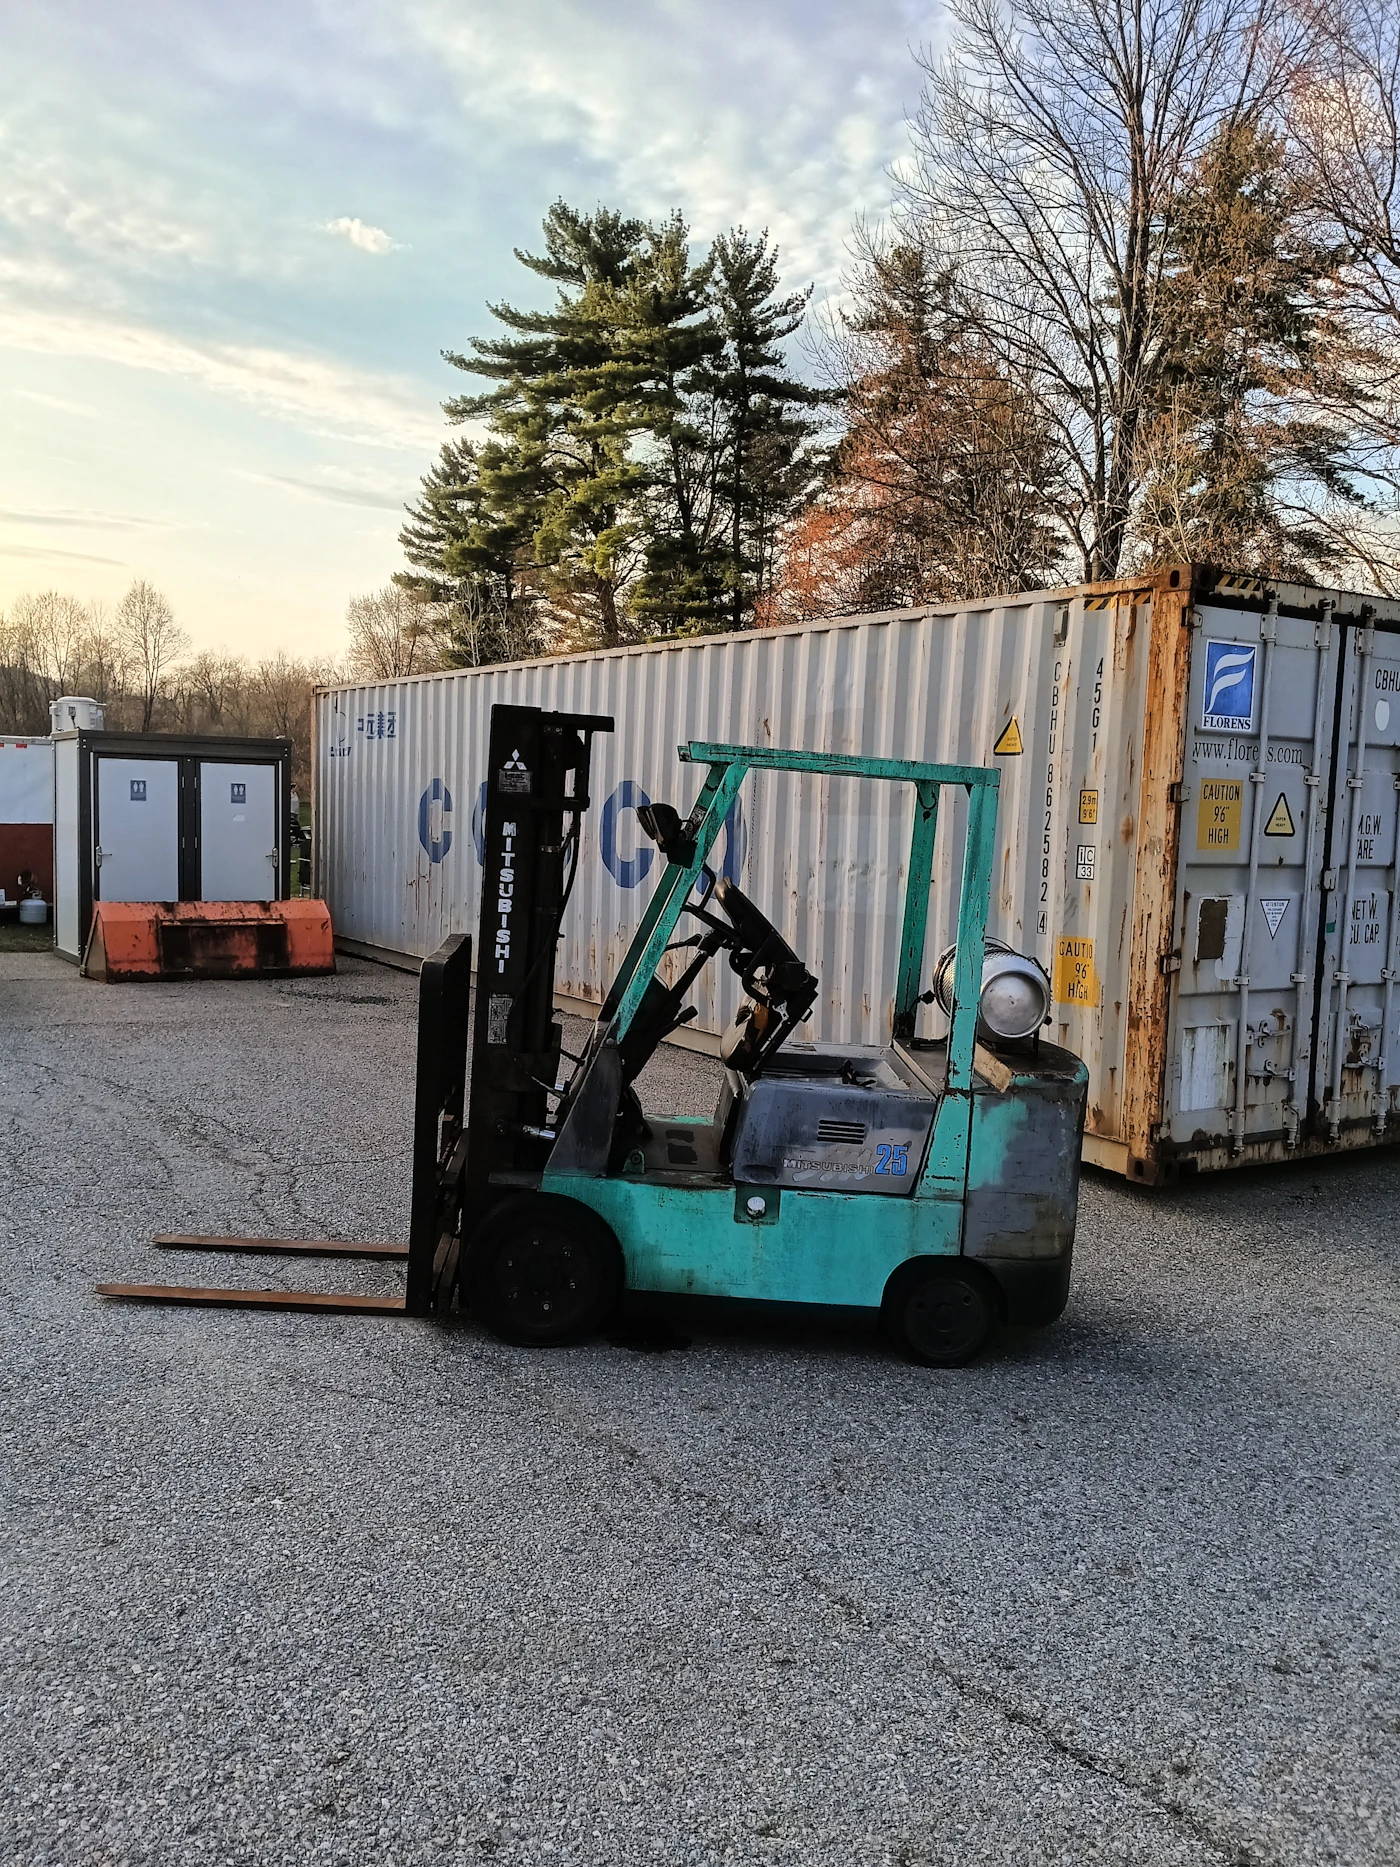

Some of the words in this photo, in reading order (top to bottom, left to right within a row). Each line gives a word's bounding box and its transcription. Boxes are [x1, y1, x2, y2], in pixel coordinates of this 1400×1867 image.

[1375, 668, 1400, 692] CBHU
[1049, 661, 1062, 754] CBHU
[1092, 657, 1104, 753] 45G1
[1203, 716, 1252, 730] FLORENS
[1192, 738, 1304, 764] www.flores.com
[1203, 784, 1241, 801] CAUTION
[1040, 763, 1054, 902] 862582
[1208, 828, 1229, 844] HIGH
[1357, 839, 1375, 860] ARE
[1080, 866, 1092, 878] 33
[494, 821, 518, 974] MITSUBISHI
[1038, 912, 1047, 933] 4
[1364, 923, 1380, 944] CAP.
[1059, 941, 1093, 959] CAUTIO
[1068, 982, 1089, 1001] HIGH
[783, 1158, 875, 1175] MITSUBISHI
[875, 1143, 908, 1176] 25
